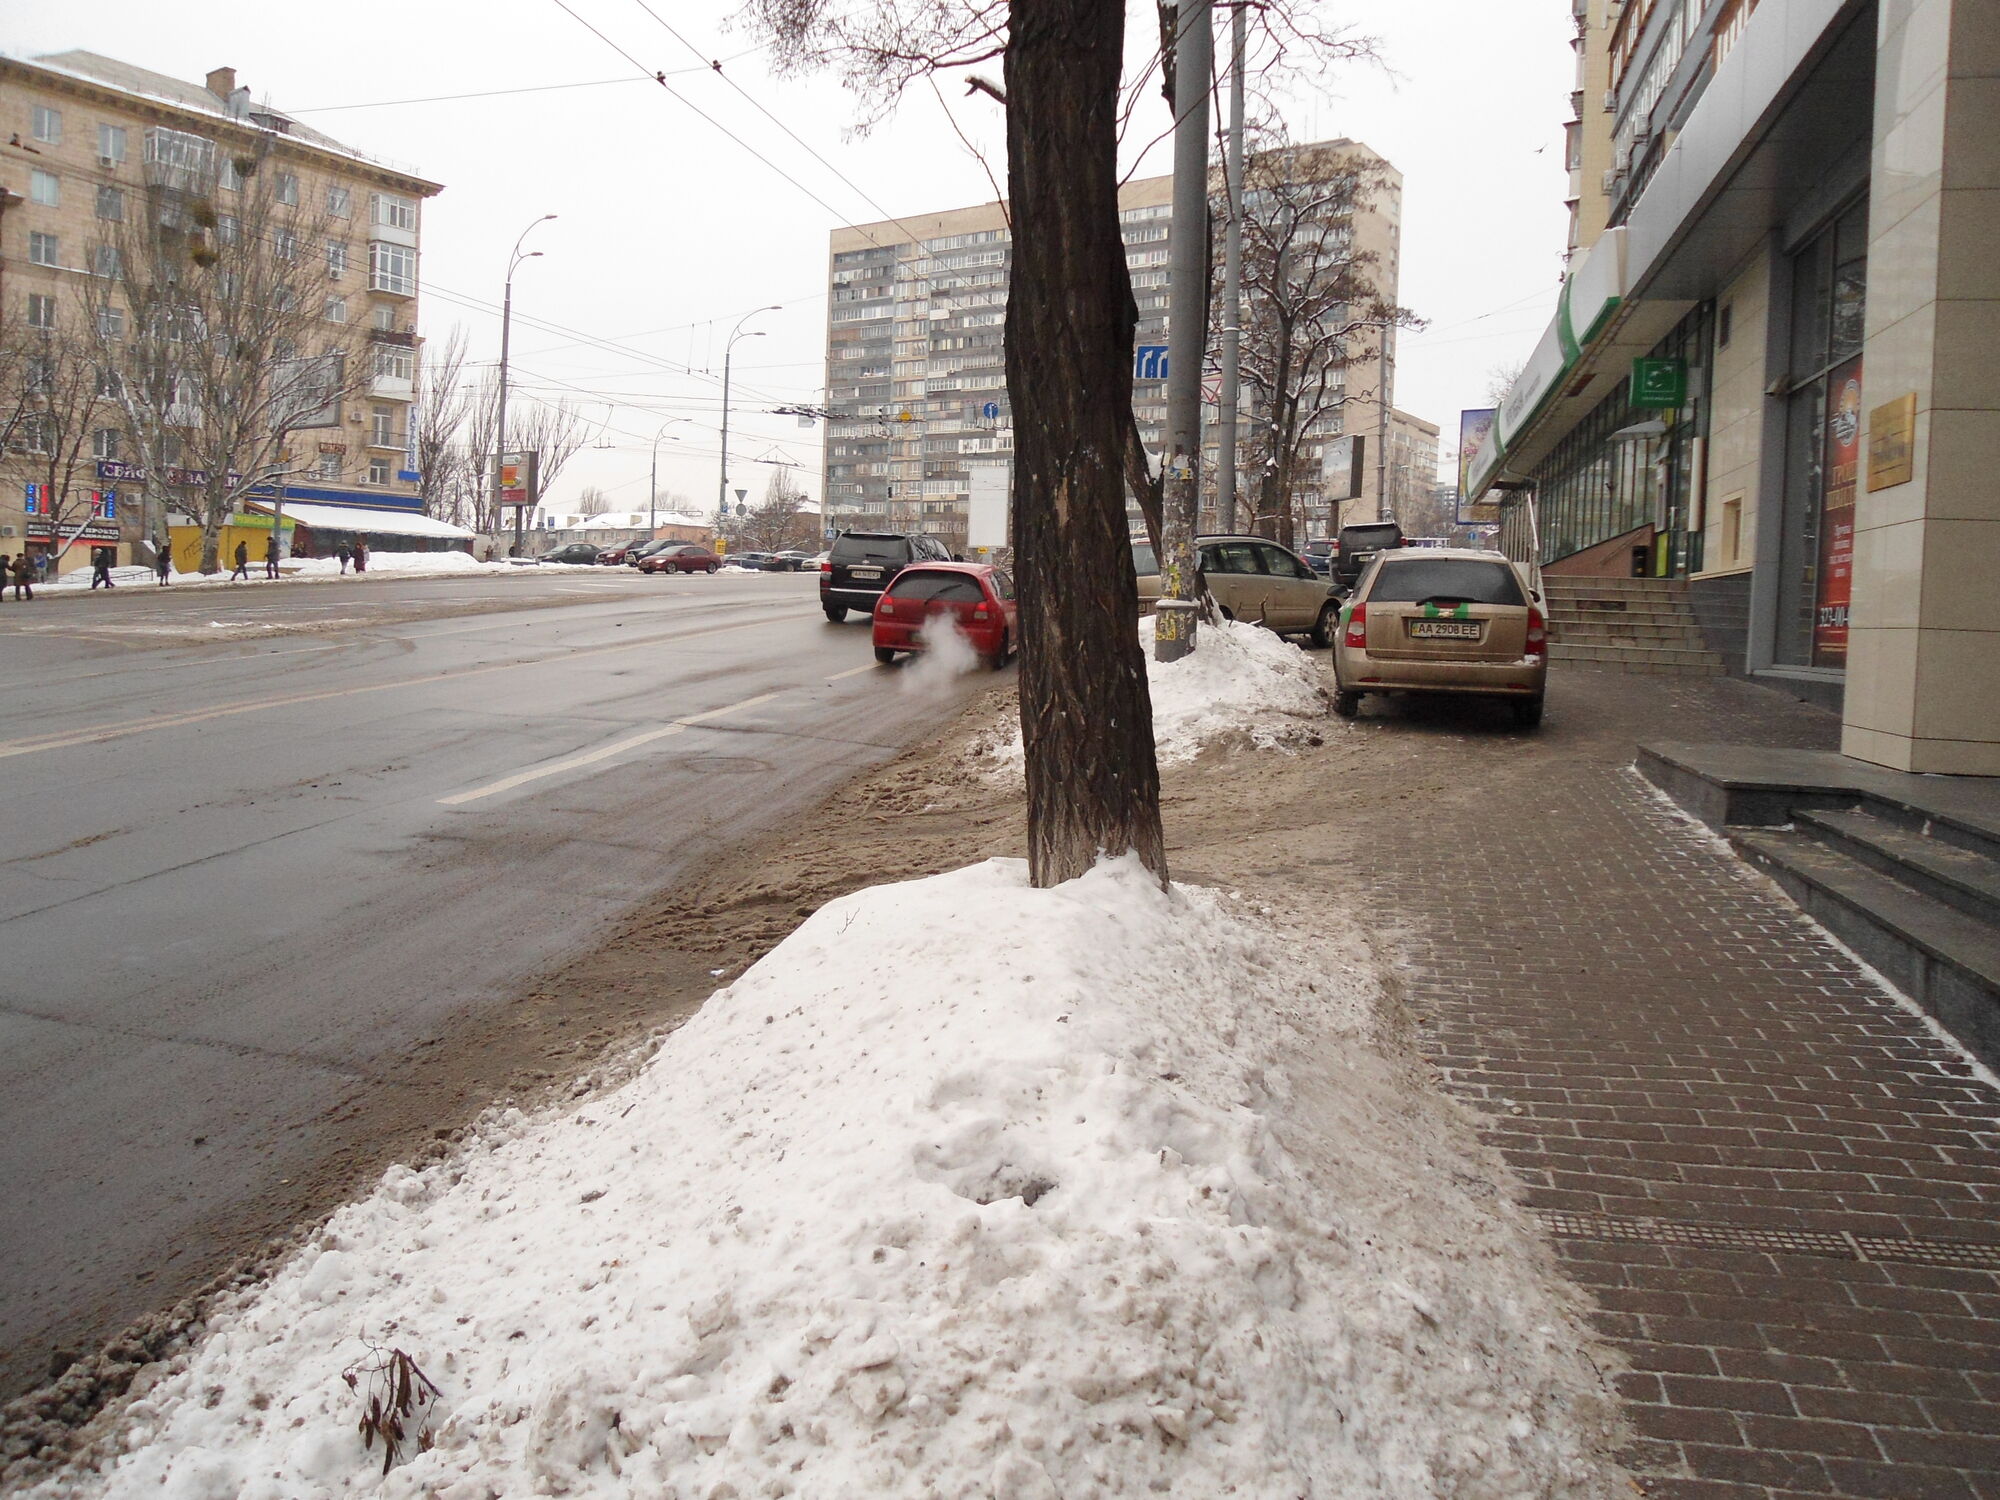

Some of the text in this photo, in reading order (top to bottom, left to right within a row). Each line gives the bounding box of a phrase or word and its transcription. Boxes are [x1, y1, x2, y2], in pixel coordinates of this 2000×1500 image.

[408, 406, 417, 471] ГАСТРОНОМ
[1418, 624, 1477, 635] AA 2908 EE
